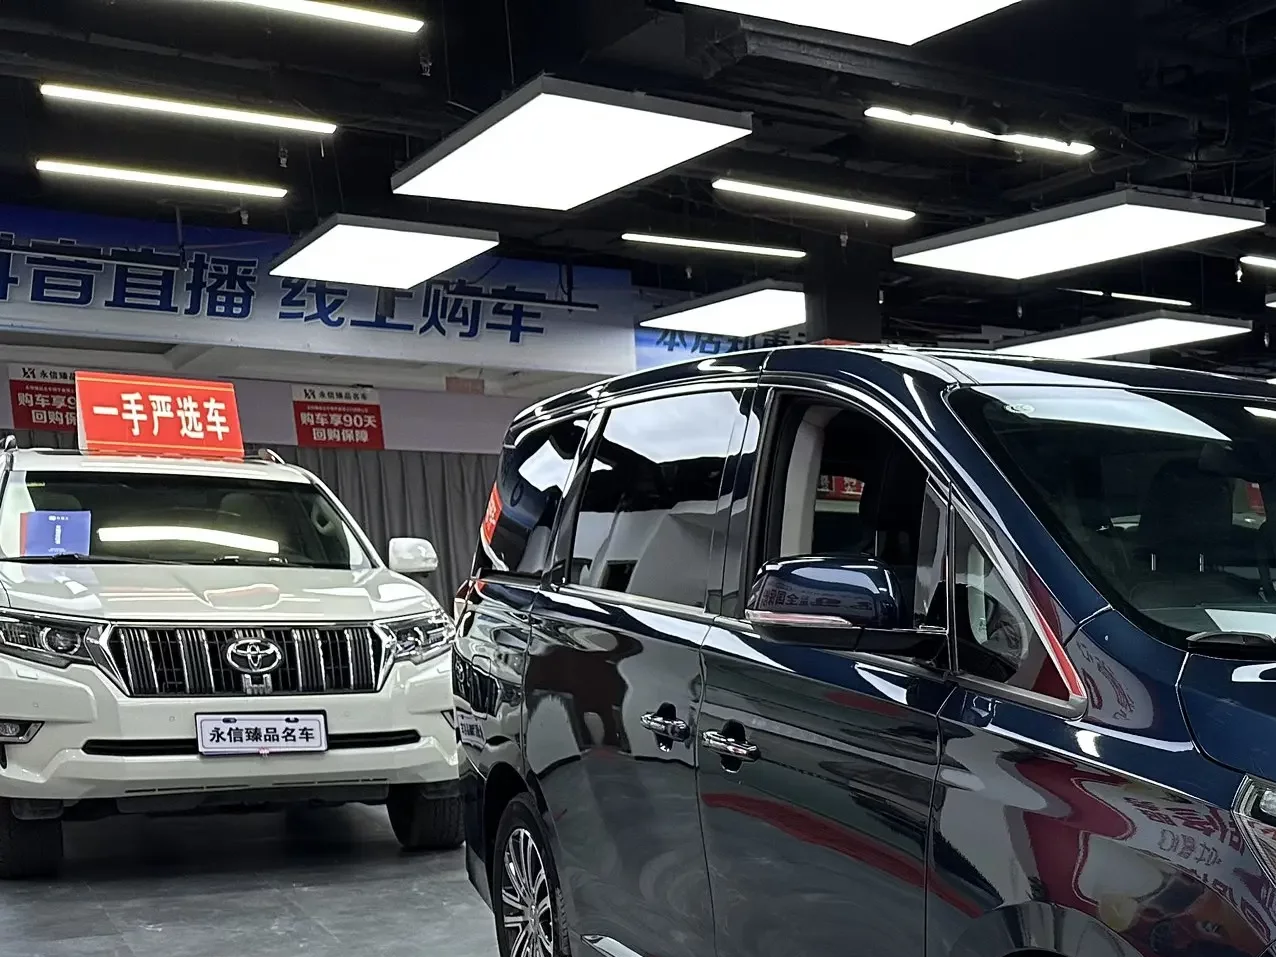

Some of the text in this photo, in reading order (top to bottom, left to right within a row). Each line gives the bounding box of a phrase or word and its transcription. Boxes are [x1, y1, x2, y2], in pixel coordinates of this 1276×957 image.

[278, 277, 547, 344] 线上购车
[93, 391, 230, 441] 一手严选车
[300, 412, 377, 428] 购车享90天
[312, 427, 369, 443] 回购保障
[209, 727, 315, 743] 永信臻品名车
